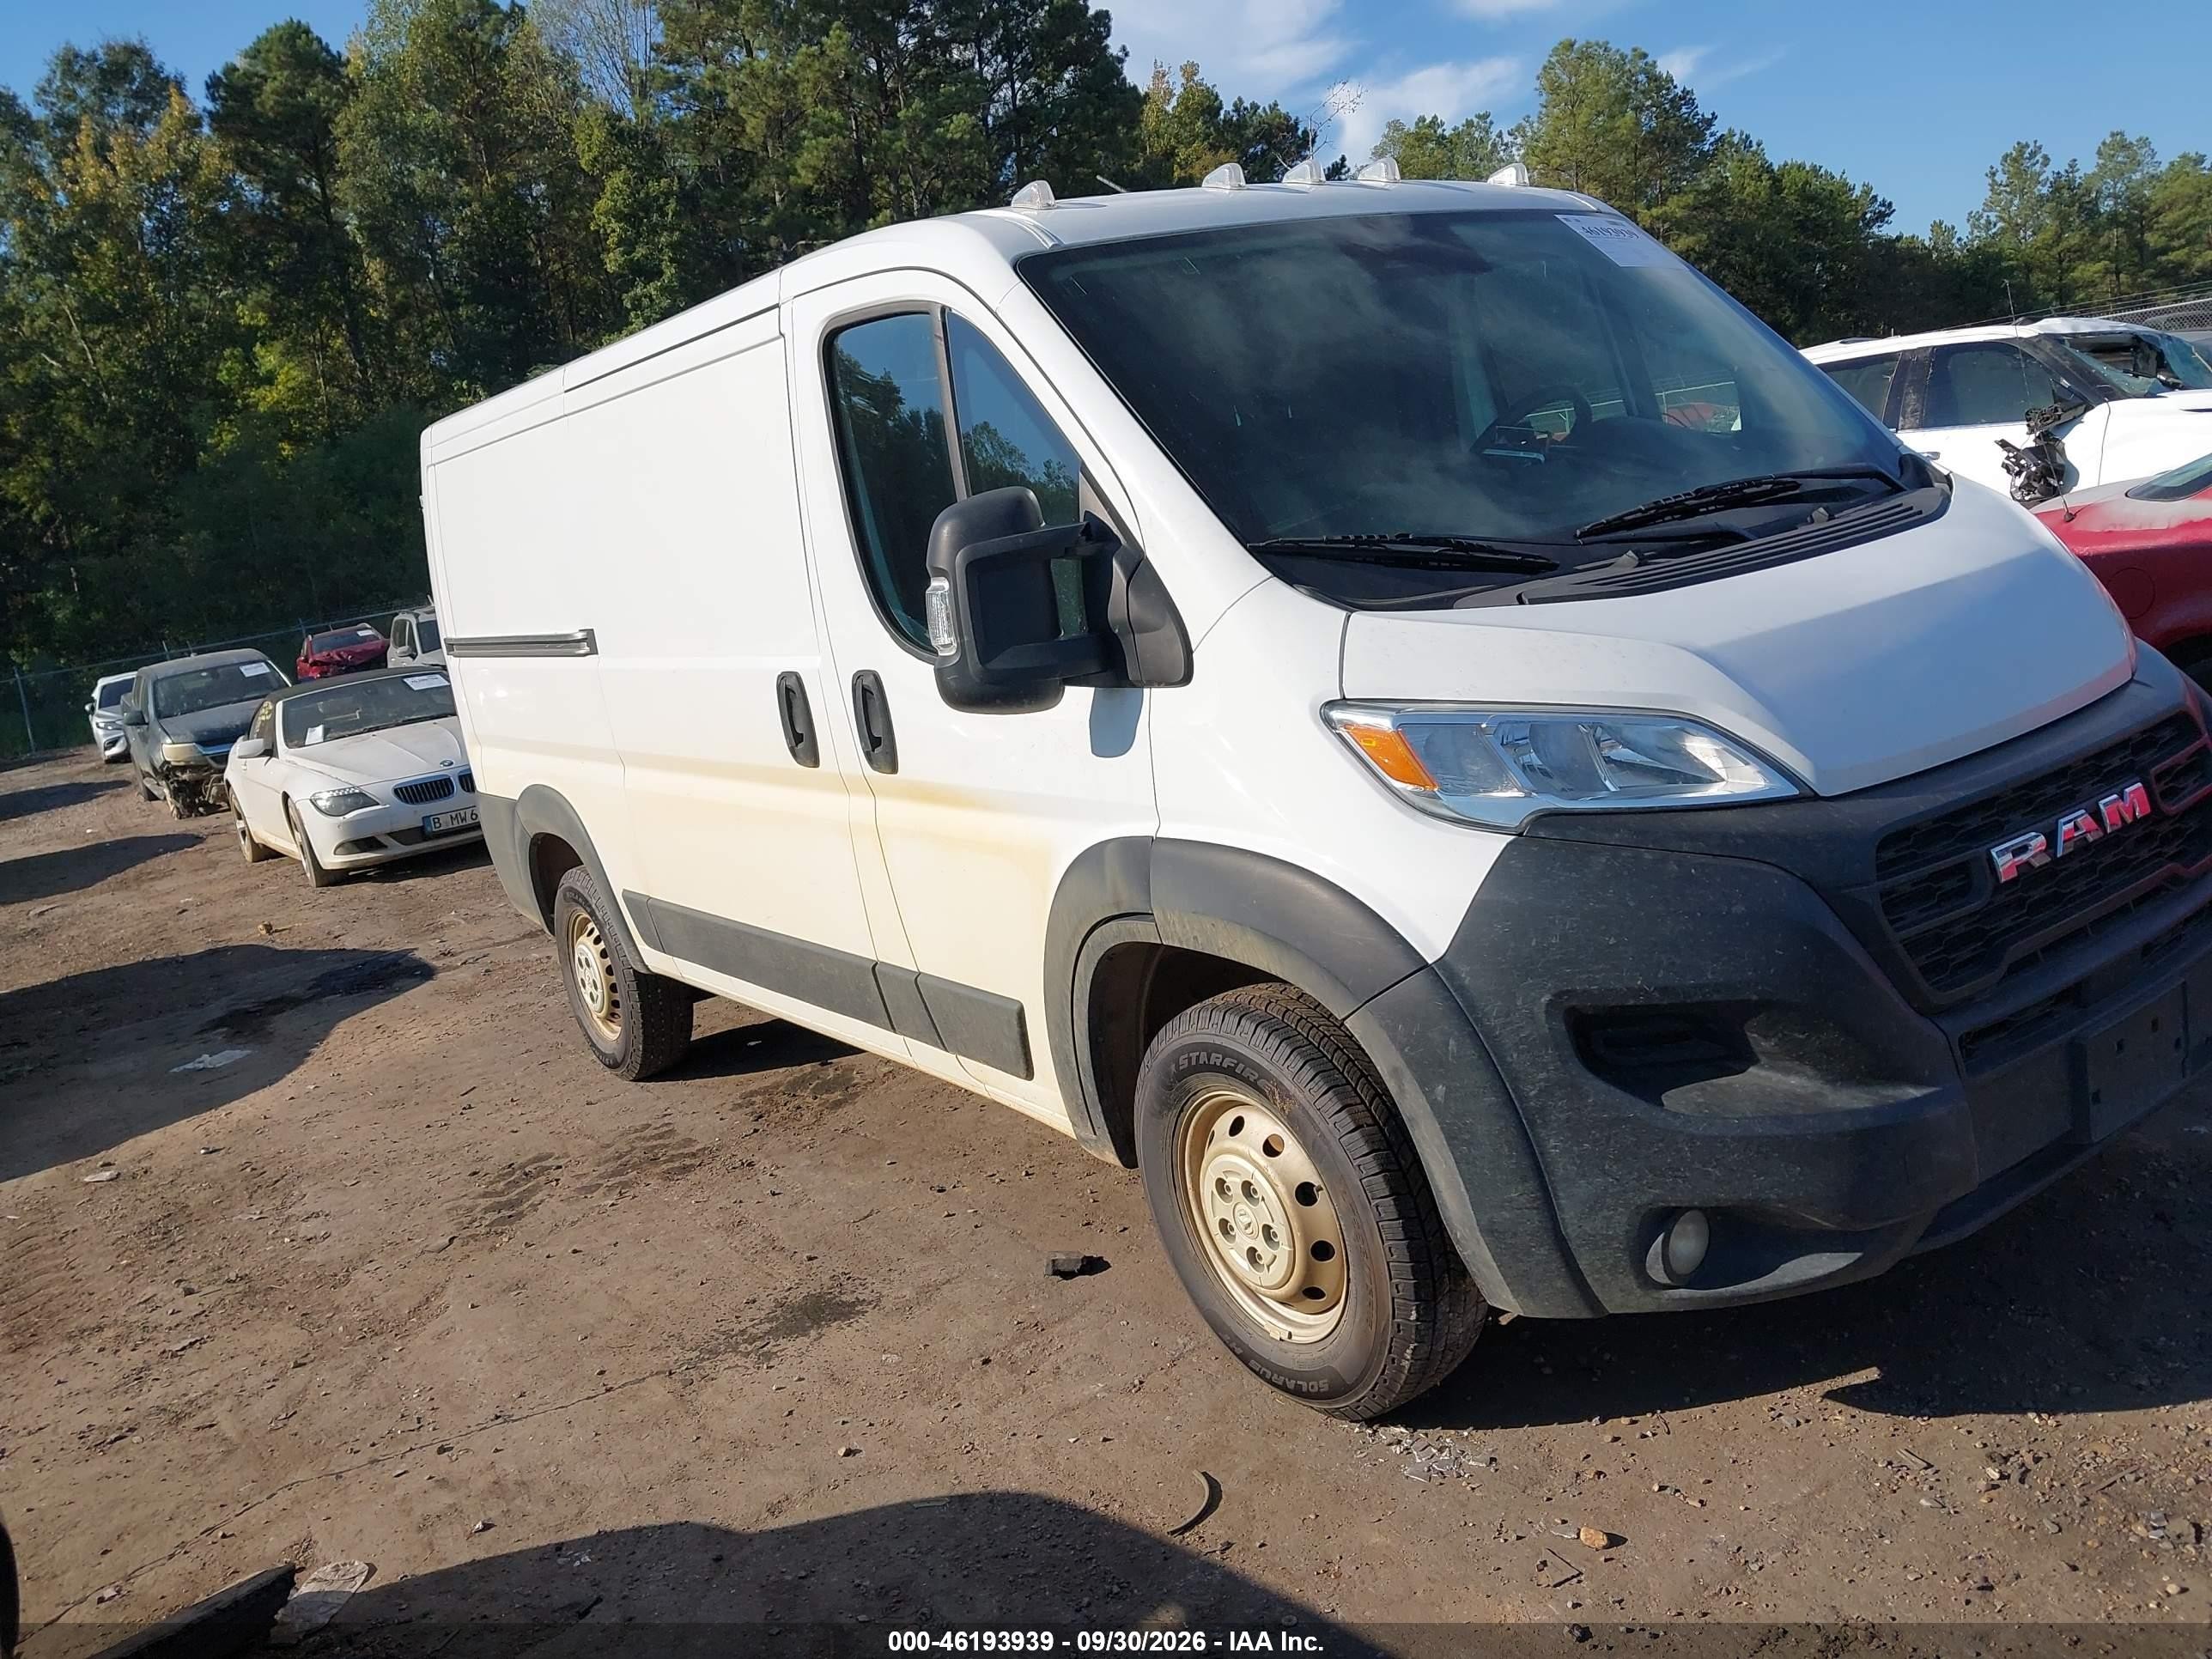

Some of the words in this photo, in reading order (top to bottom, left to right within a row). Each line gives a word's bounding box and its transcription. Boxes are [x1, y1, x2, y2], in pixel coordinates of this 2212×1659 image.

[432, 817, 441, 830] B
[450, 810, 467, 825] MW
[1990, 782, 2151, 884] RAM
[1178, 1051, 1273, 1093] STARFIRE
[1248, 1359, 1329, 1393] SOLARUS
